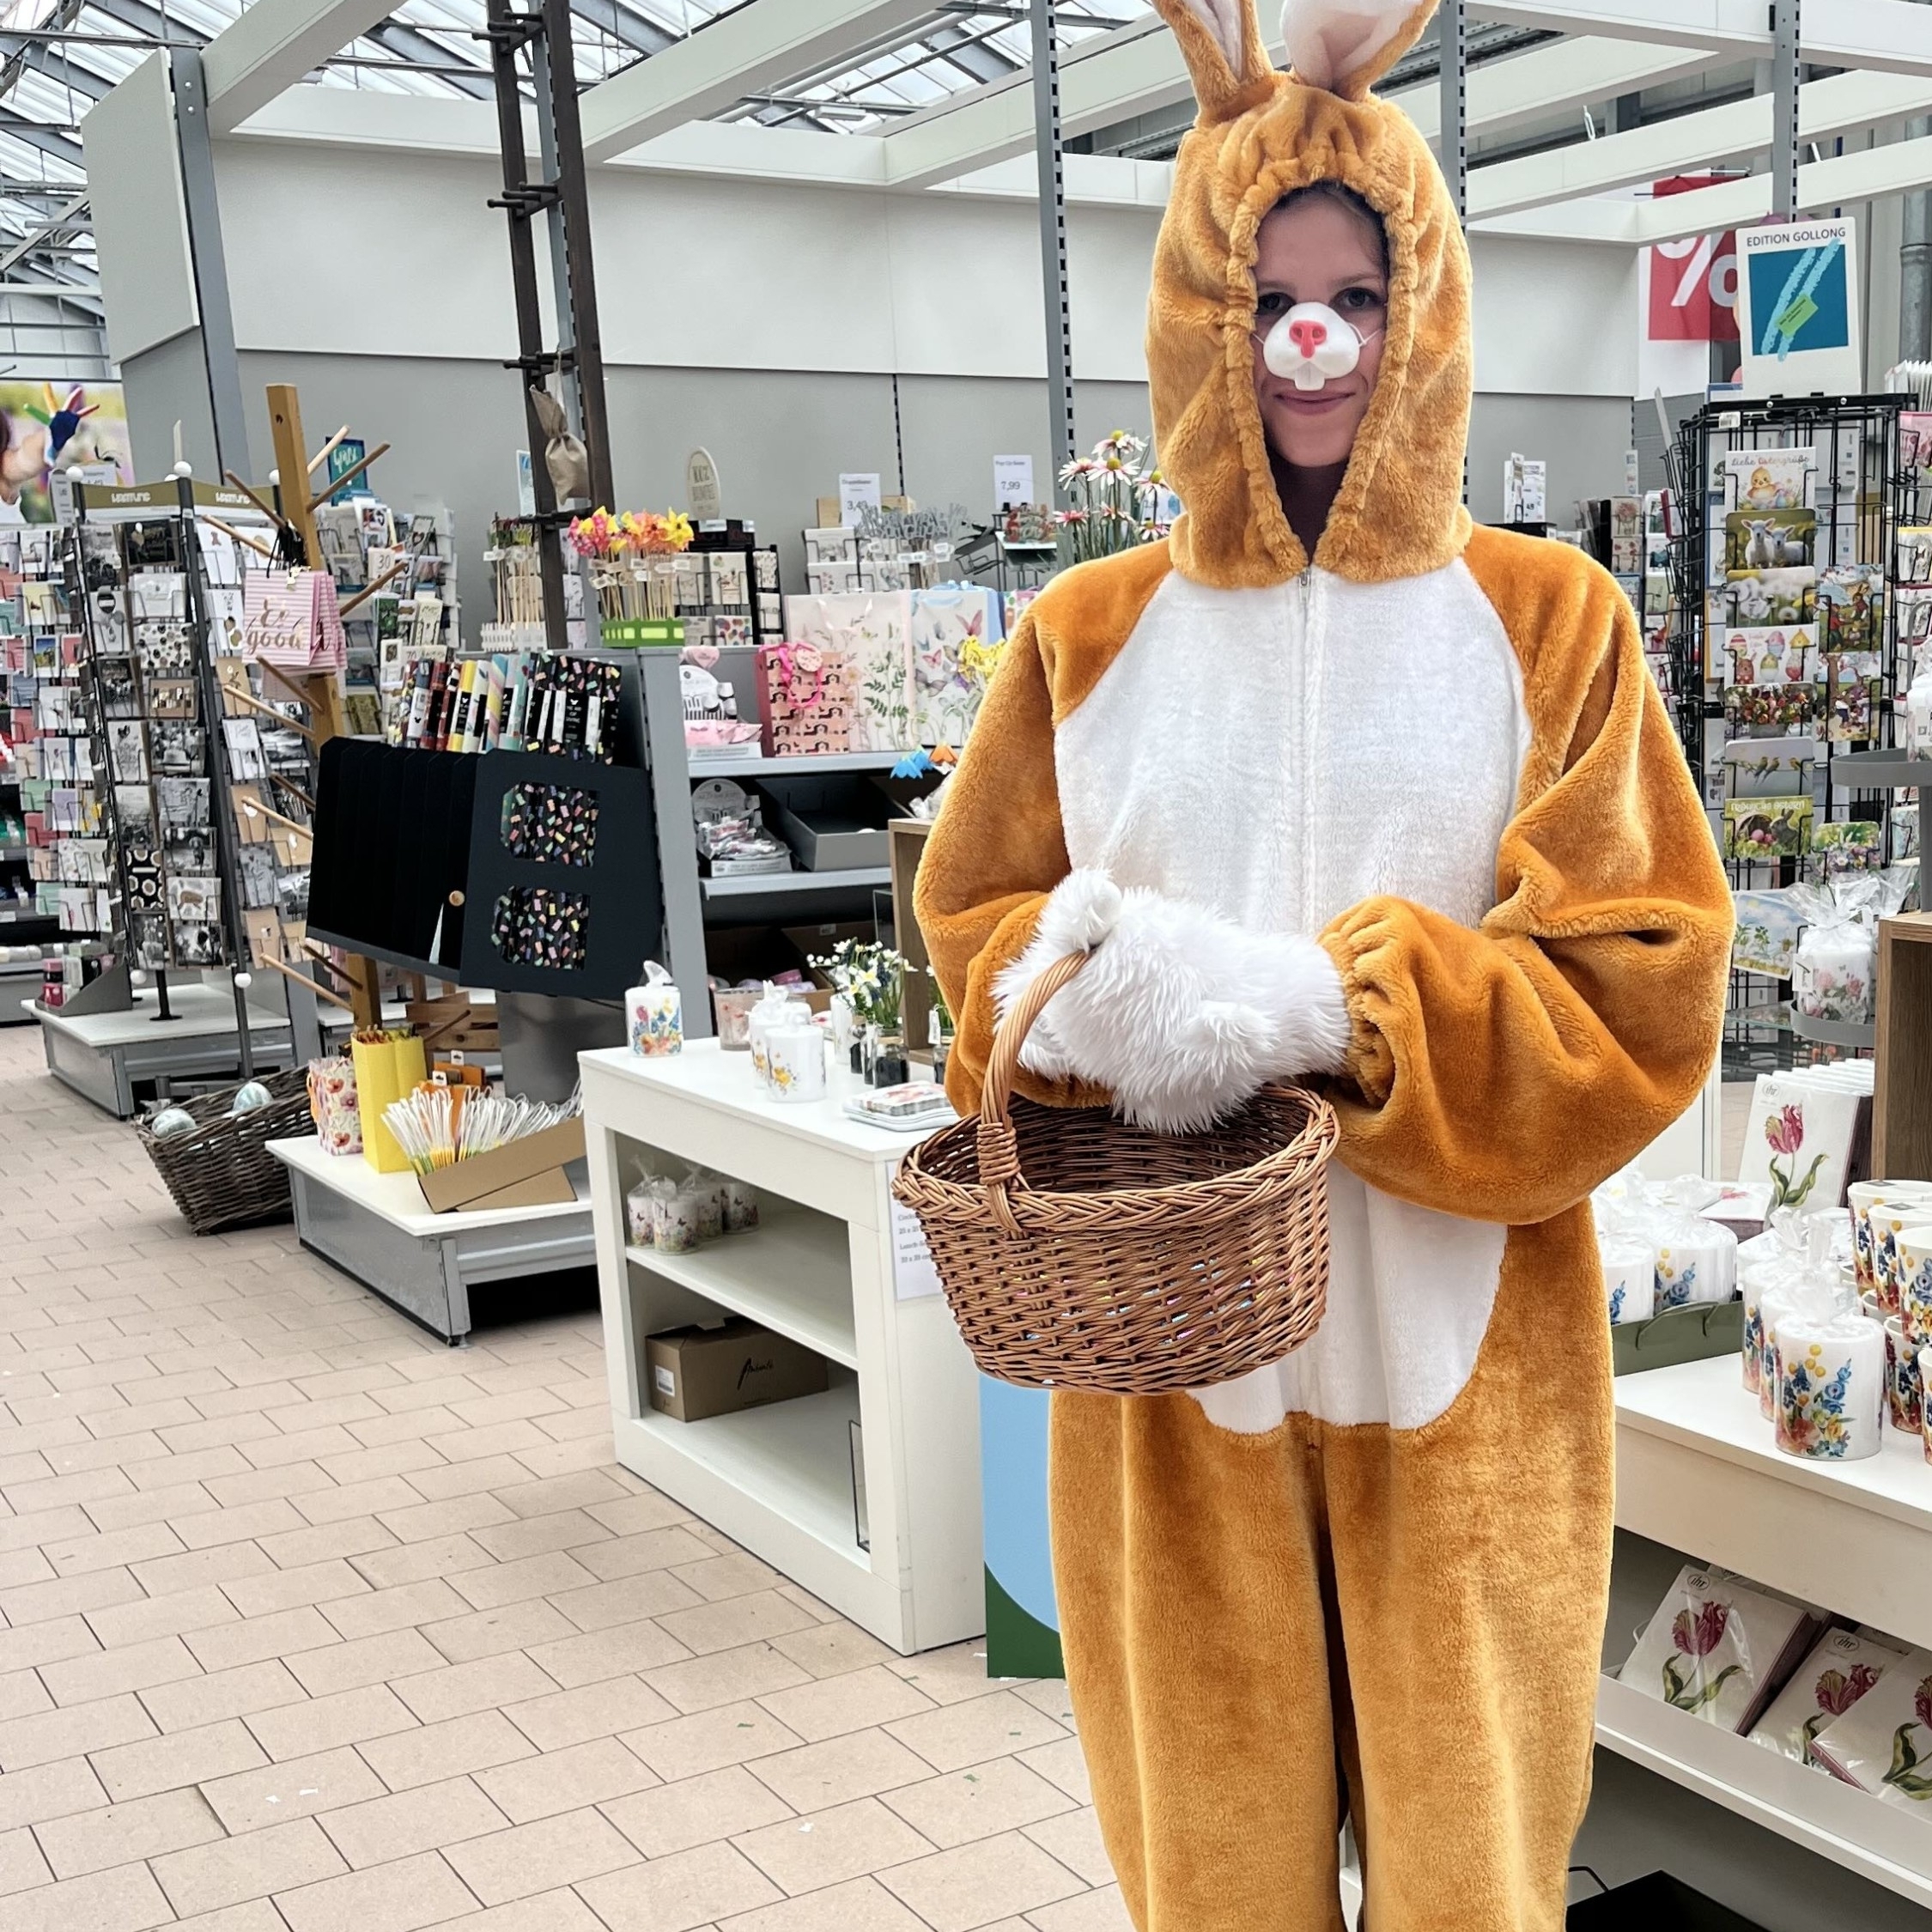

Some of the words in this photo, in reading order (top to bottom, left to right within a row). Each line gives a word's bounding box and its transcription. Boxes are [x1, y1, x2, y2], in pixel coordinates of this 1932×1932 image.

[1747, 234, 1789, 246] EDITION
[1793, 227, 1846, 242] GOLLONG
[1000, 481, 1021, 491] 7,99
[378, 554, 391, 569] 30
[1690, 1577, 1708, 1588] ihr
[1838, 1637, 1856, 1649] ihr
